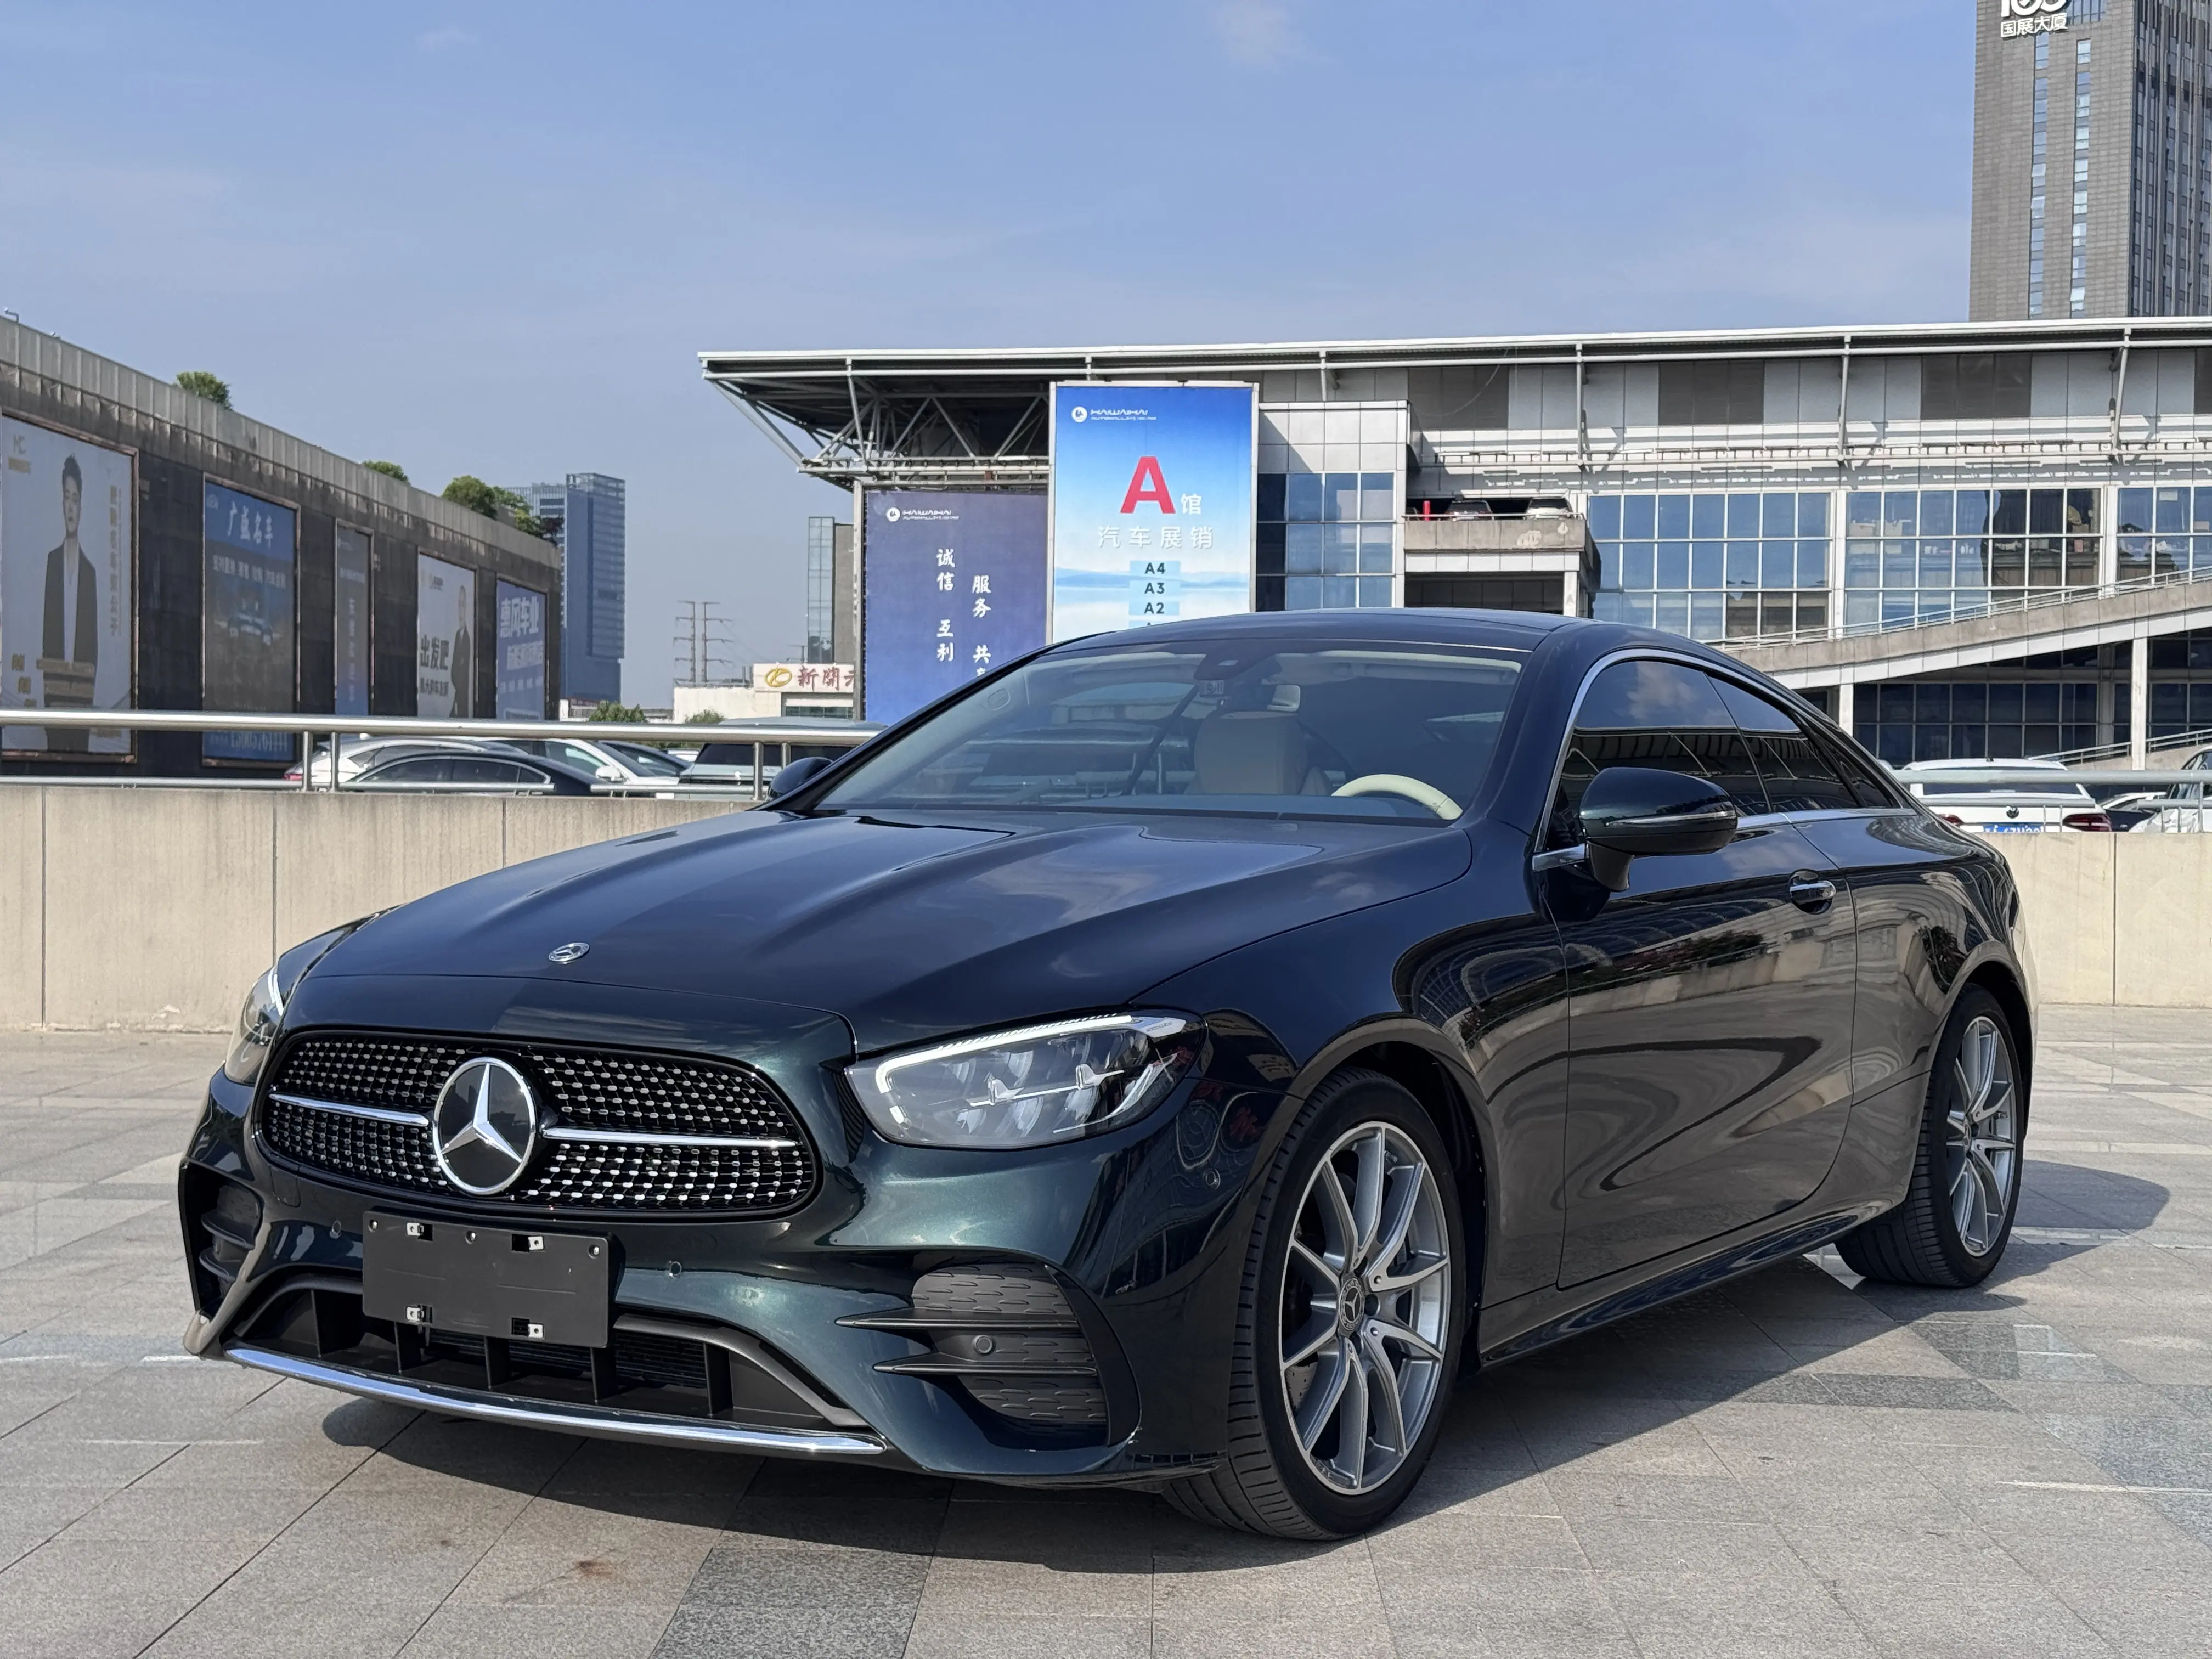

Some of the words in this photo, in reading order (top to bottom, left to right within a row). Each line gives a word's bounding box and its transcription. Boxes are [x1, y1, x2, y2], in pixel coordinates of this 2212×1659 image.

[2001, 12, 2068, 38] 国展大厦
[1098, 525, 1214, 549] 汽车展销
[936, 548, 956, 592] 诚信
[1144, 562, 1166, 574] A4
[972, 574, 992, 618] 服务
[1144, 582, 1165, 595] A3
[1144, 602, 1165, 614] A2
[420, 634, 449, 670] 出发吧
[935, 619, 955, 663] 互利
